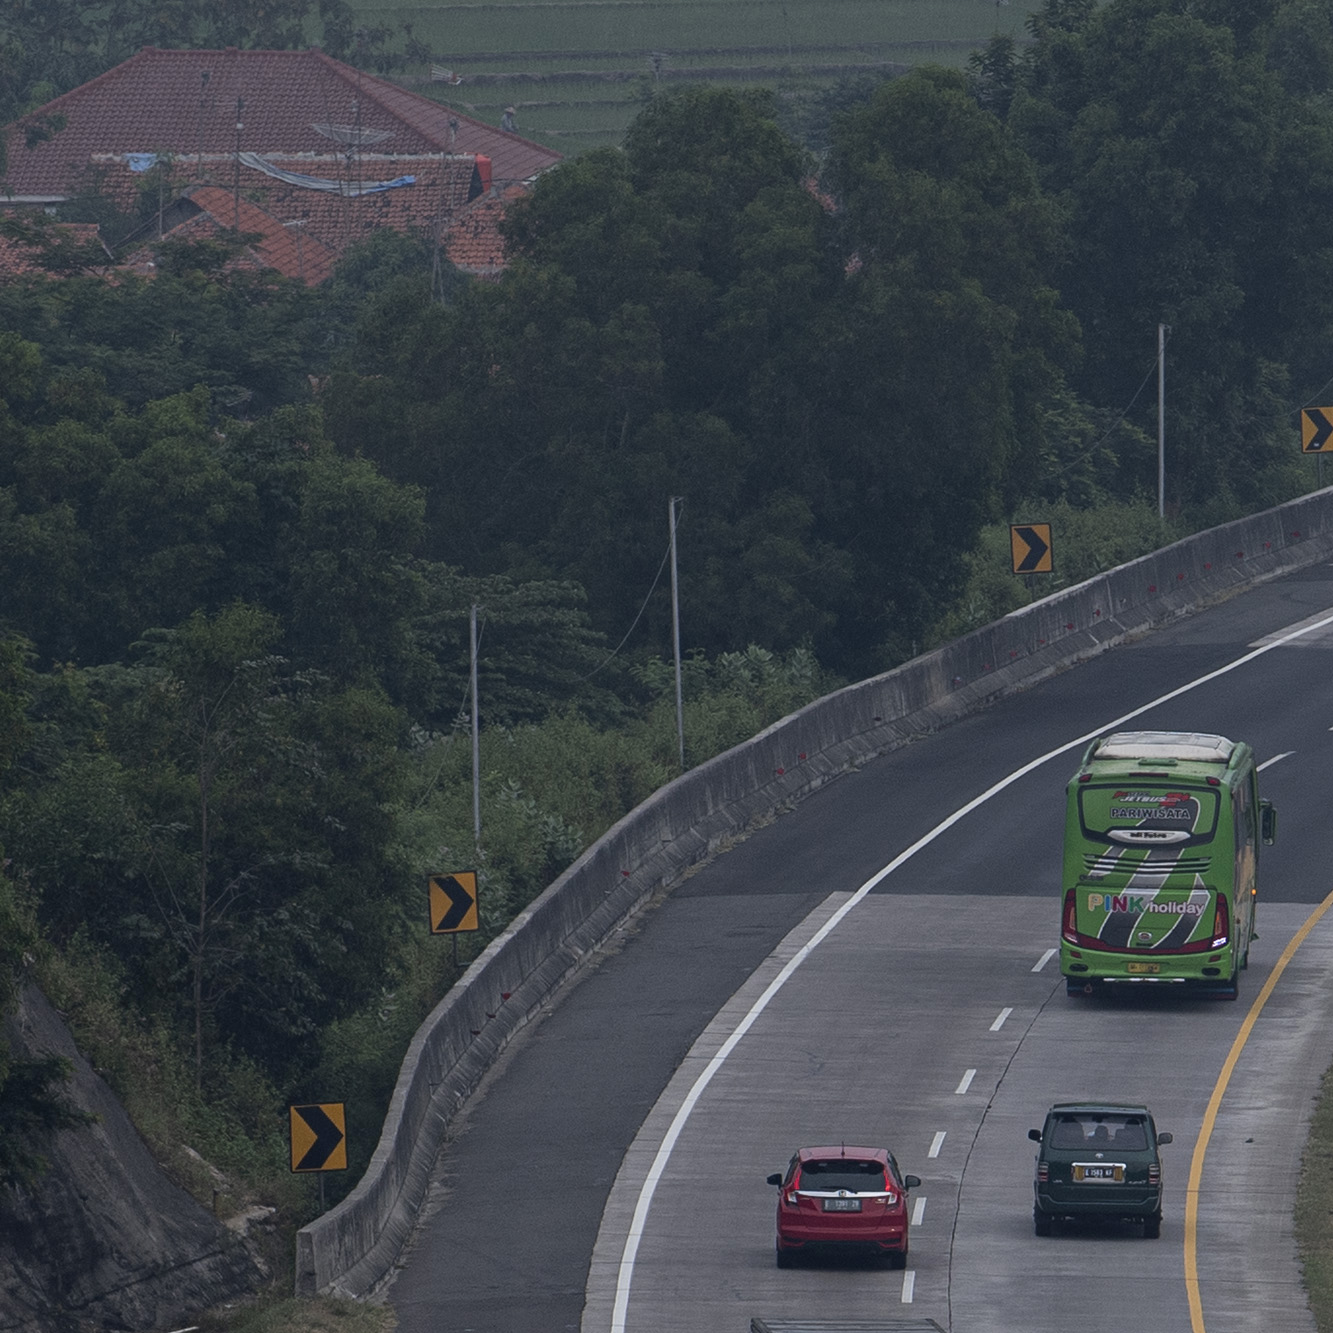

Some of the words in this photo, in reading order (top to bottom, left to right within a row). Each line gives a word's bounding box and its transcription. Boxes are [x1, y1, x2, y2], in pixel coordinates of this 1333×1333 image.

[1110, 807, 1191, 820] PARIWISATA
[1088, 893, 1145, 913] PINK
[1149, 901, 1205, 916] holiday
